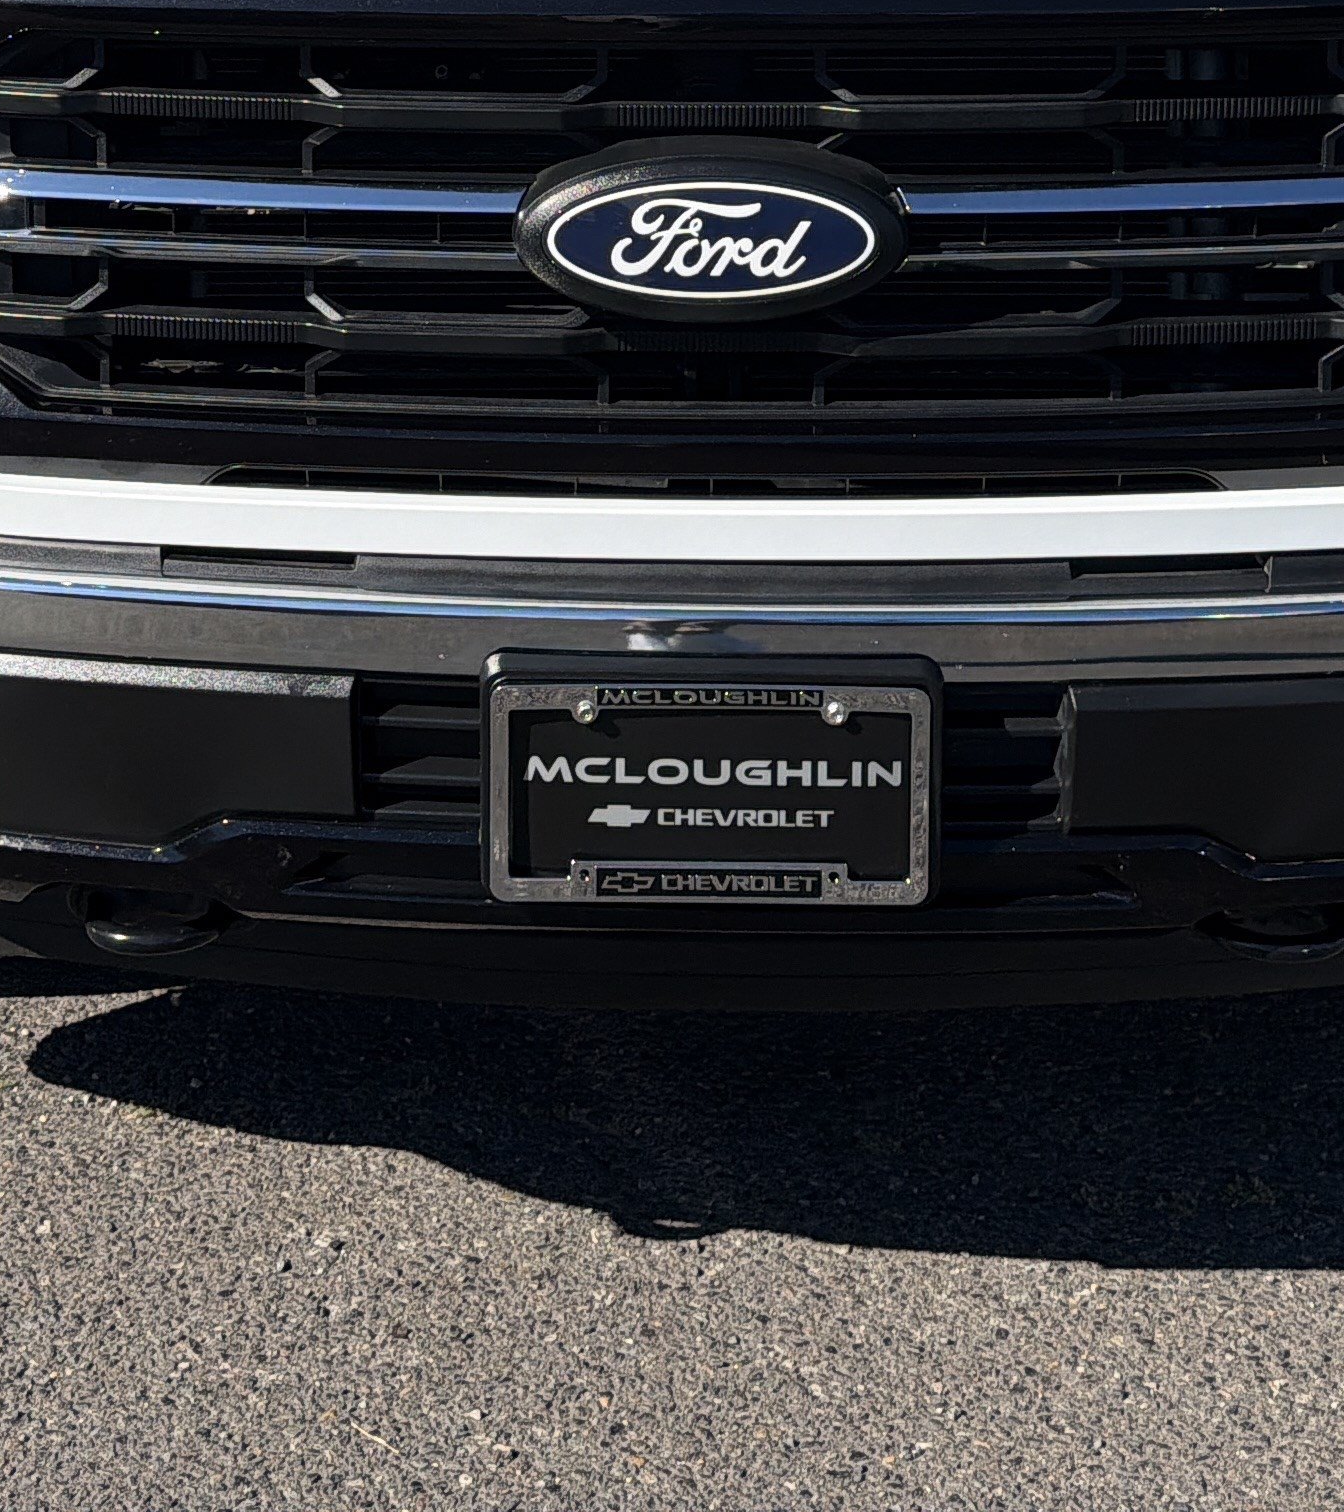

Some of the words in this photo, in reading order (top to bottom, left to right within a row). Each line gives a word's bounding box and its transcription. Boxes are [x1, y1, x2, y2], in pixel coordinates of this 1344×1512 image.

[610, 197, 813, 278] Ford
[601, 690, 820, 705] MCLOUGHLIN
[526, 755, 903, 787] MCLOUGHLIN
[657, 808, 835, 828] CHEVROLET
[661, 874, 819, 892] CHEVROLET
